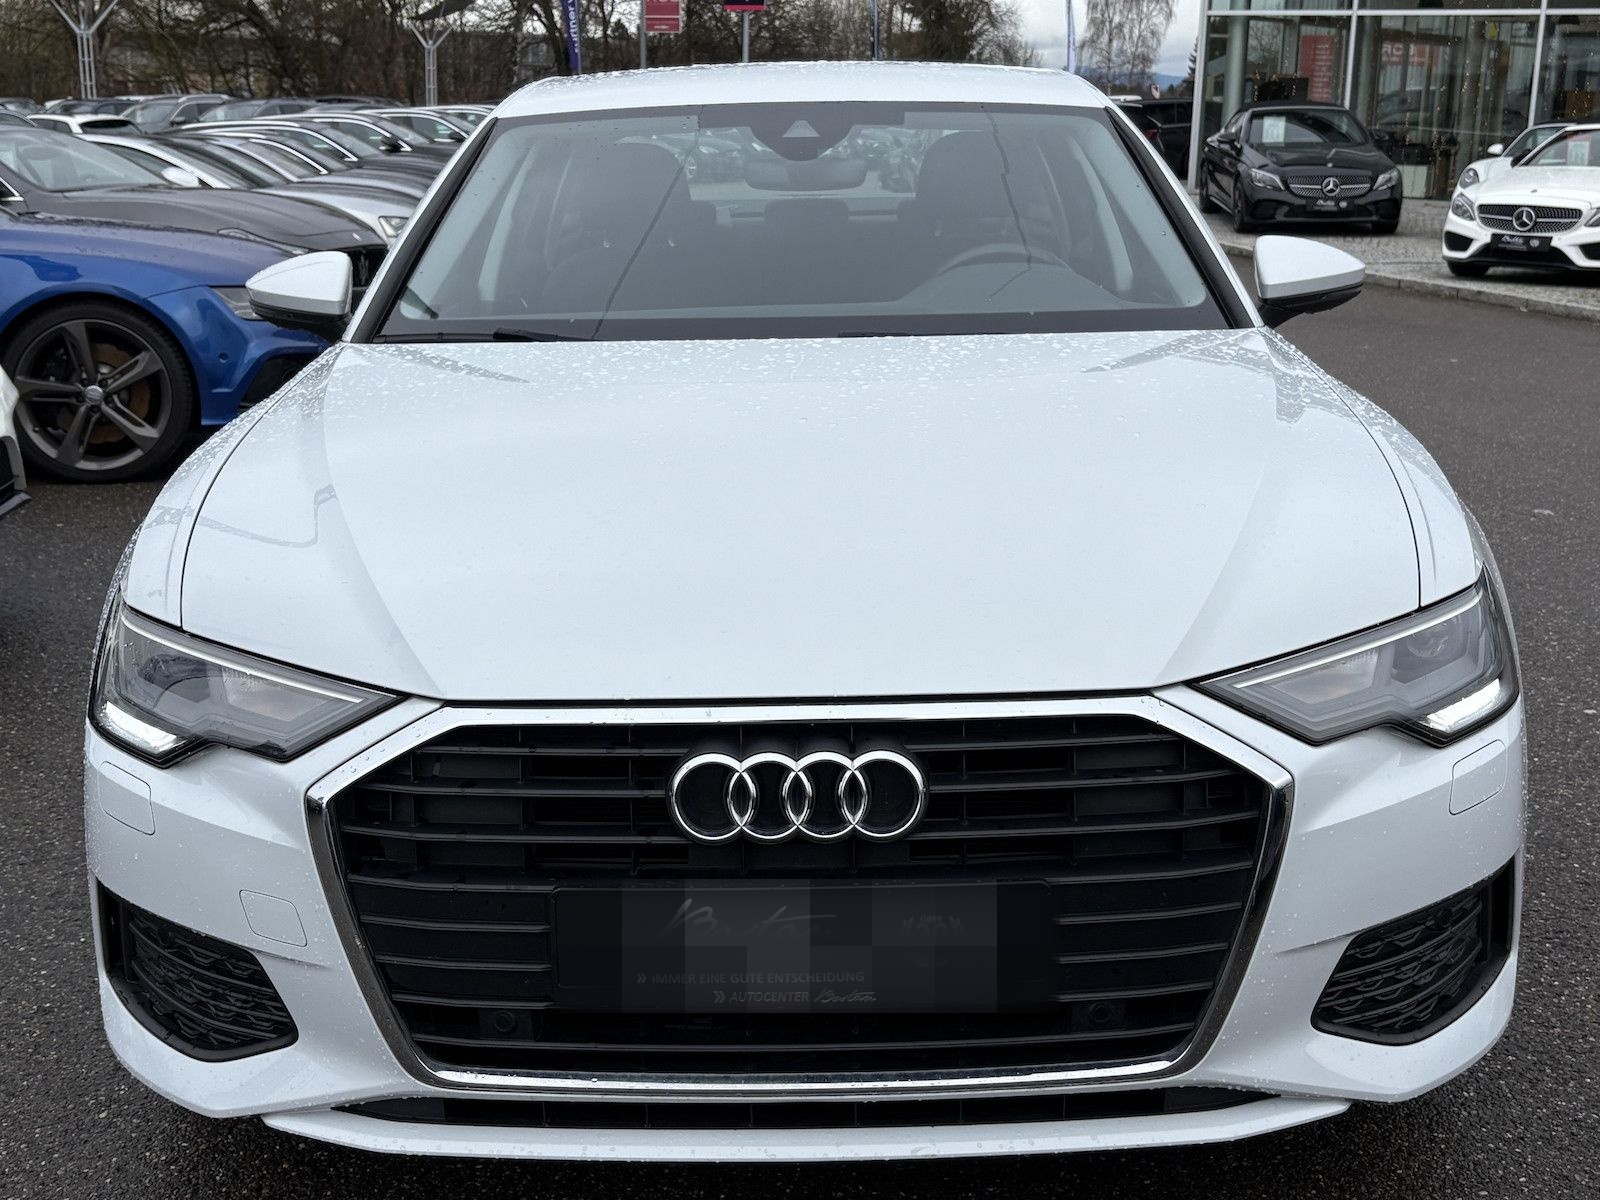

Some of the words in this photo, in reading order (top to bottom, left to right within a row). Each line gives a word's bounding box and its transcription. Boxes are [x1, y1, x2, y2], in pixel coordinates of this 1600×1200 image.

[919, 914, 943, 923] ÜBER
[651, 973, 696, 984] IMMER
[700, 973, 727, 984] EINE
[730, 972, 764, 983] GUTE
[767, 971, 865, 983] ENTSCHEIDUNG
[729, 991, 809, 1003] AUTOCENTER
[814, 987, 877, 1003] Bostan
